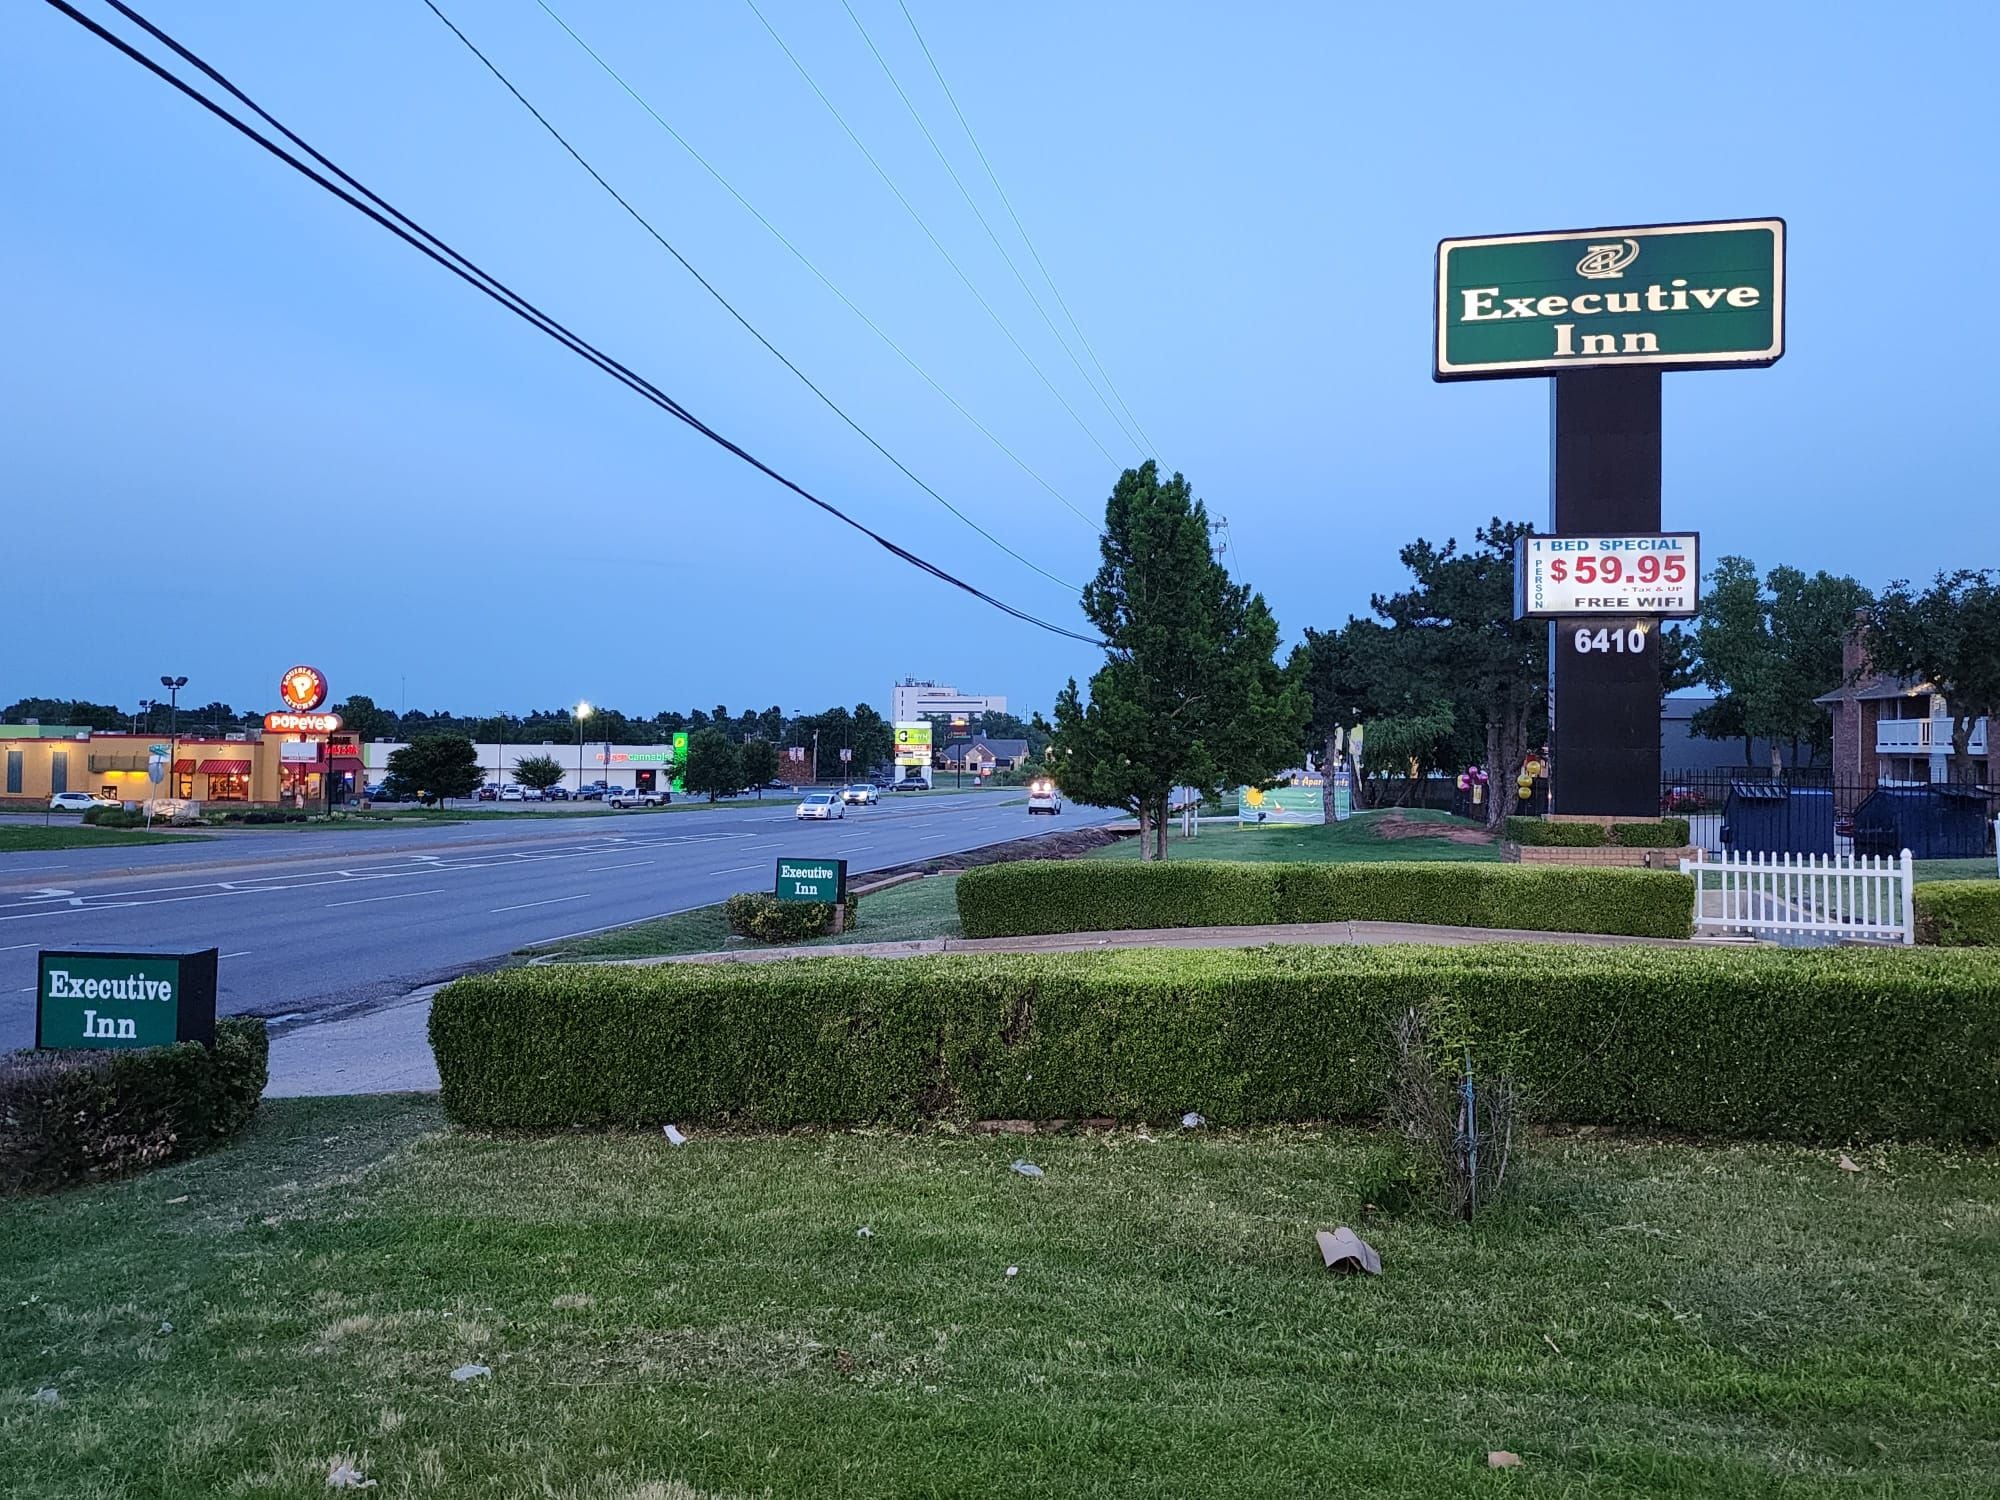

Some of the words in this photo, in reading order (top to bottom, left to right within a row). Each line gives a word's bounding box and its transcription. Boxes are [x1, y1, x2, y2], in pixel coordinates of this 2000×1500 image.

[1460, 279, 1760, 322] Executive
[1552, 323, 1660, 356] Inn
[1533, 541, 1541, 552] 1
[1551, 541, 1589, 551] BED
[1599, 539, 1683, 551] SPECIAL
[1534, 559, 1544, 609] PERSON
[1550, 555, 1687, 585] $59.95
[1574, 597, 1630, 608] FREE
[1637, 596, 1684, 608] WIFI
[1574, 628, 1646, 654] 6410
[283, 667, 320, 686] LOUISIANA
[781, 865, 833, 879] Executive
[795, 882, 818, 895] Inn
[48, 970, 172, 1002] Executive
[82, 1009, 137, 1039] Inn
